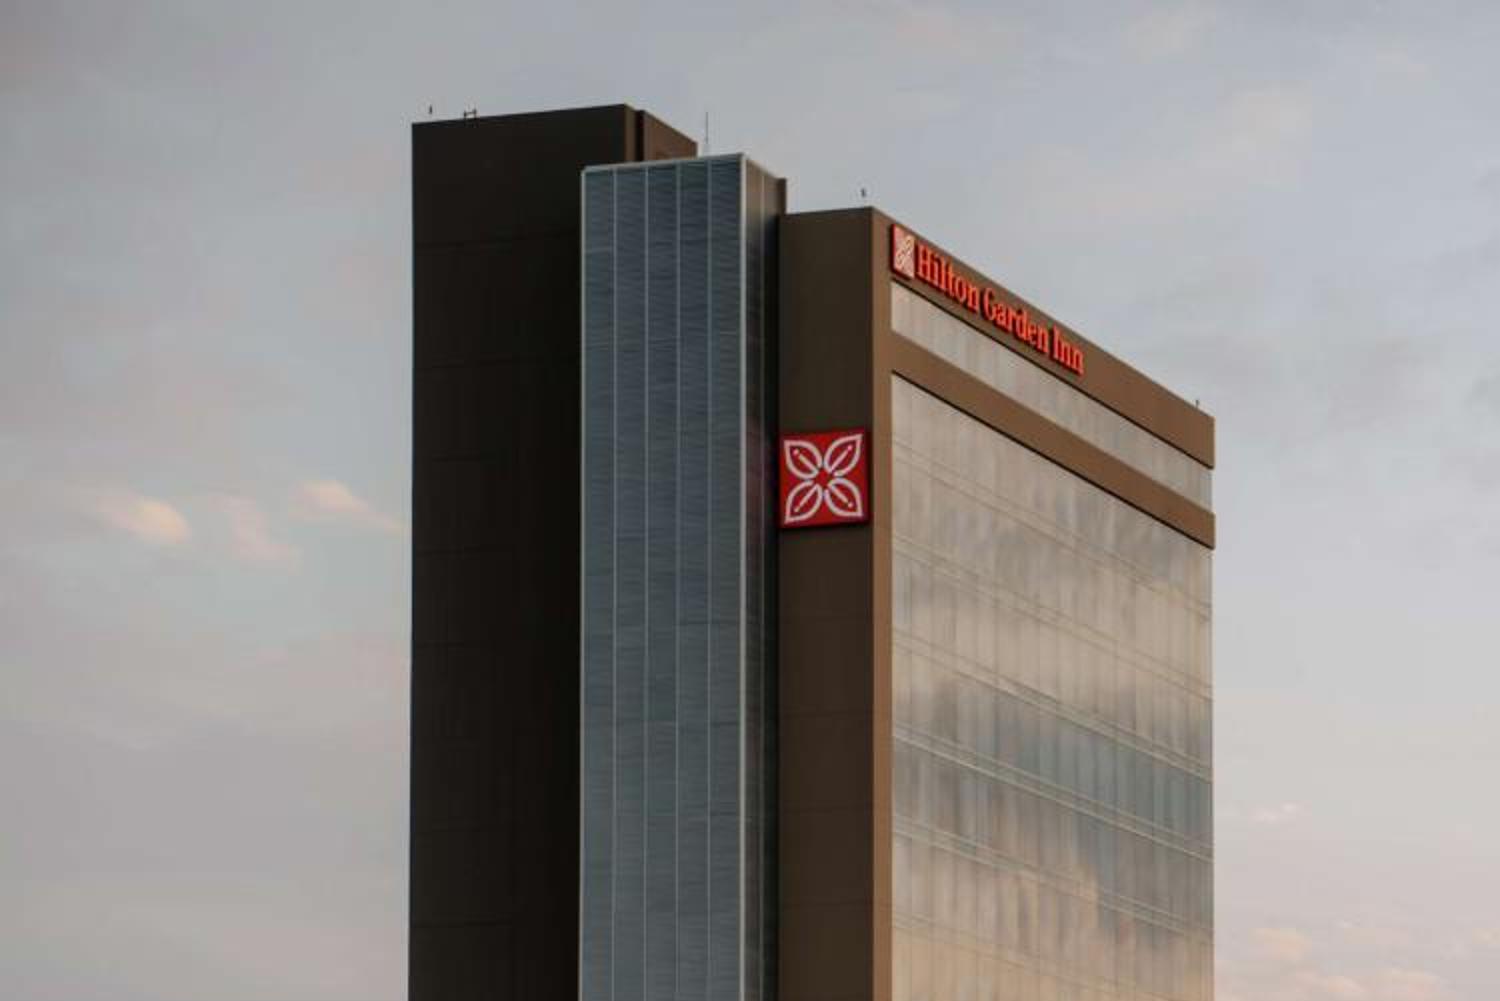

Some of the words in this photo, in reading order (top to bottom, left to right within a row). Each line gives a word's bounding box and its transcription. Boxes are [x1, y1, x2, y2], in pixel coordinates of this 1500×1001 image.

[917, 243, 980, 314] Hilton
[983, 287, 1049, 353] Garden
[1052, 324, 1085, 376] Inn
